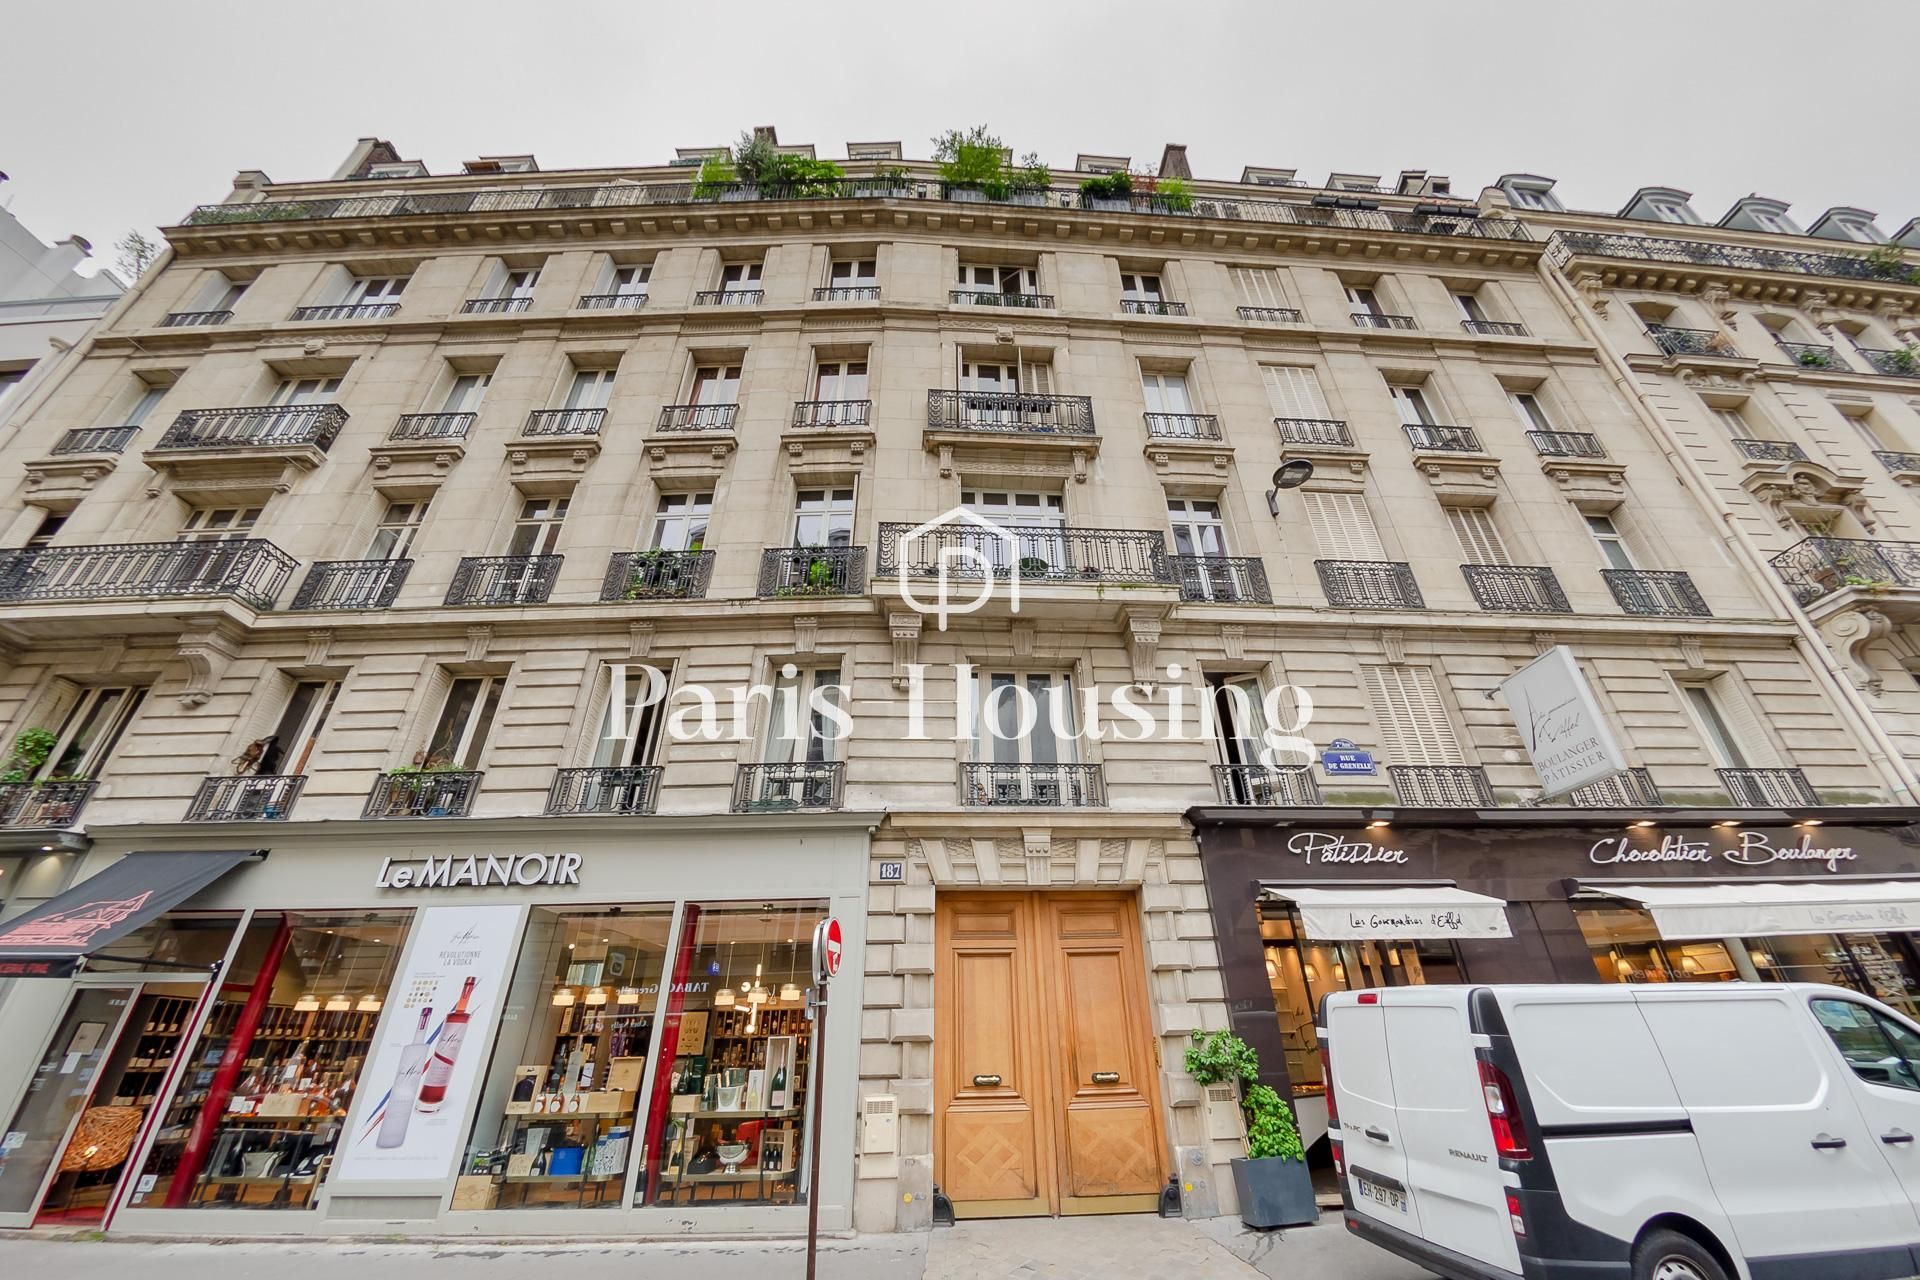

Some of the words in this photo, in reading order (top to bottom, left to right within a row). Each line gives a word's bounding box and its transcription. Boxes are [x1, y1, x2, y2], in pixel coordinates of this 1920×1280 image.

[1537, 736, 1600, 772] BOULANGER
[1287, 832, 1409, 865] Pâtissier
[1590, 835, 1712, 864] Chocolatier
[1722, 832, 1857, 872] Boulanger
[881, 863, 901, 878] 187
[1349, 912, 1366, 929] Les
[1370, 914, 1423, 928] Gourmandises
[1448, 1148, 1489, 1164] RENAULT
